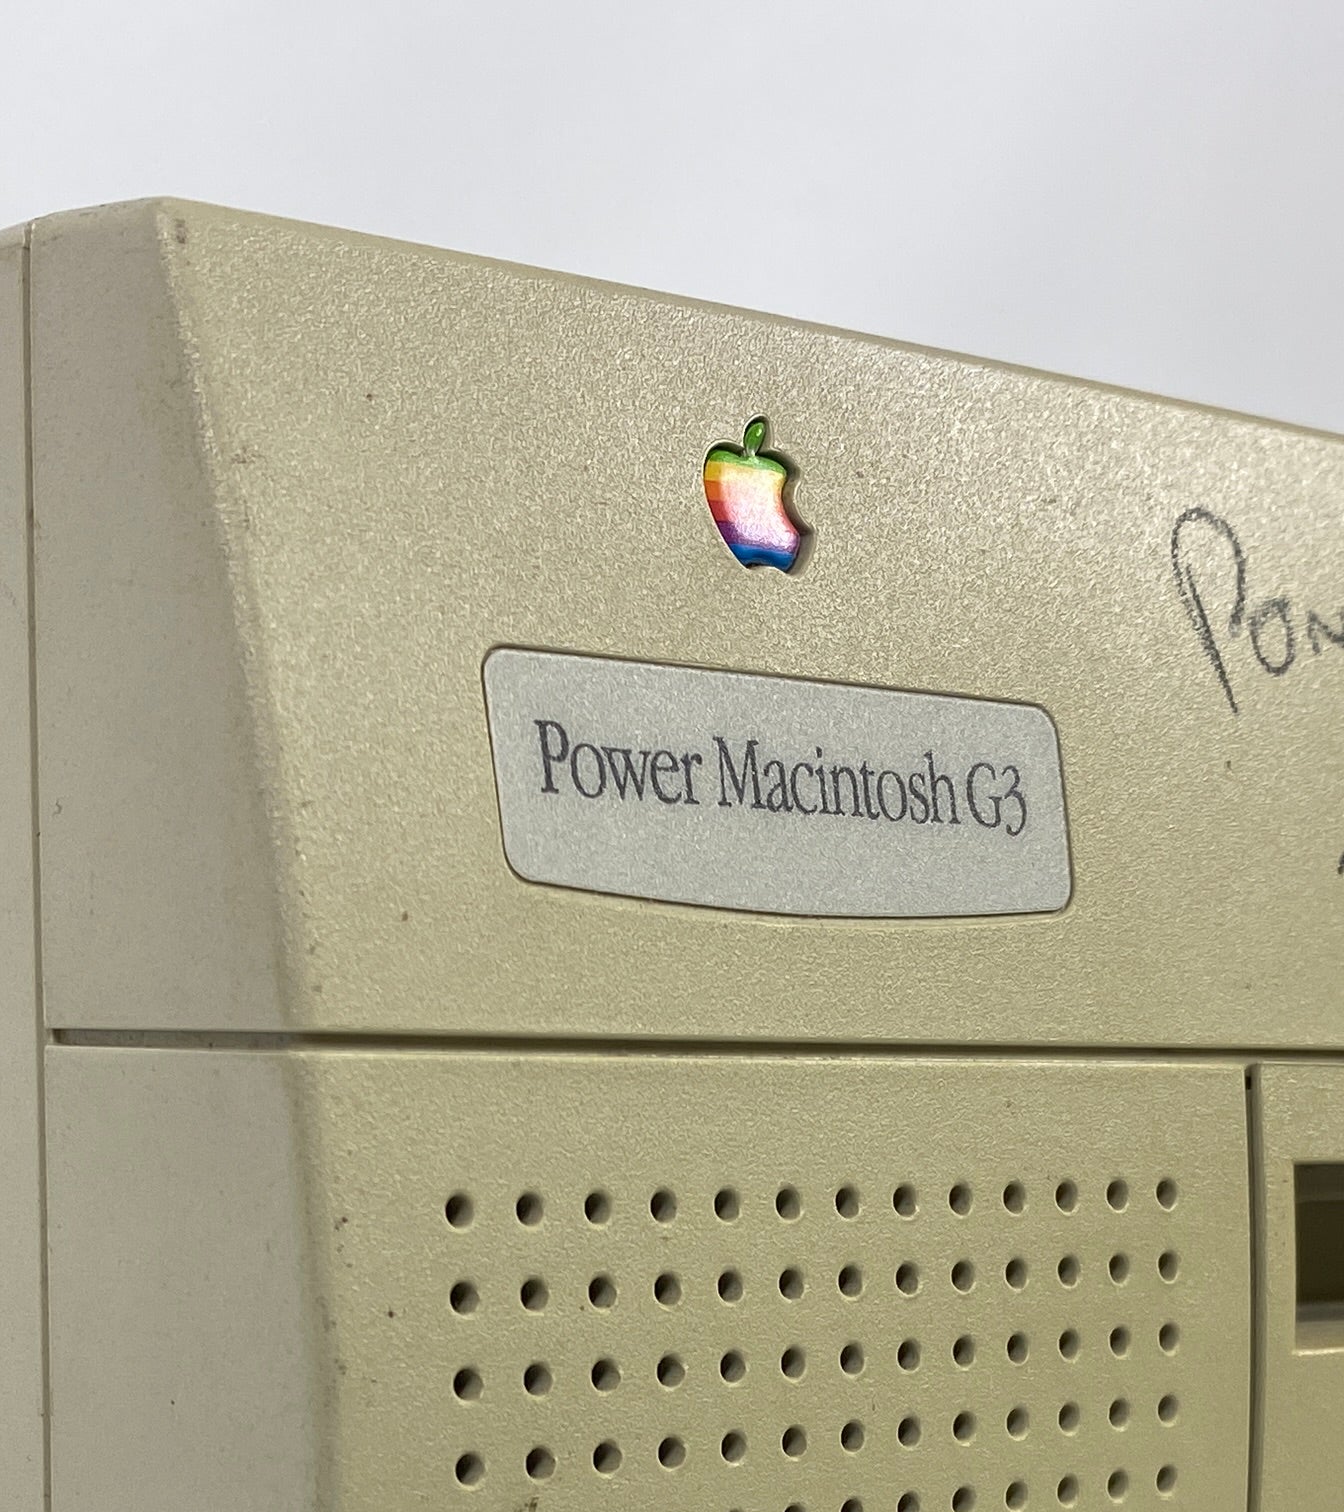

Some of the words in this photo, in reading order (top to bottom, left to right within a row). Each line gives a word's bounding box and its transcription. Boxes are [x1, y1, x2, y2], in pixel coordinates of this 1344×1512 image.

[533, 718, 703, 807] Power
[711, 734, 962, 826] Macintosh
[965, 761, 1028, 838] G3
